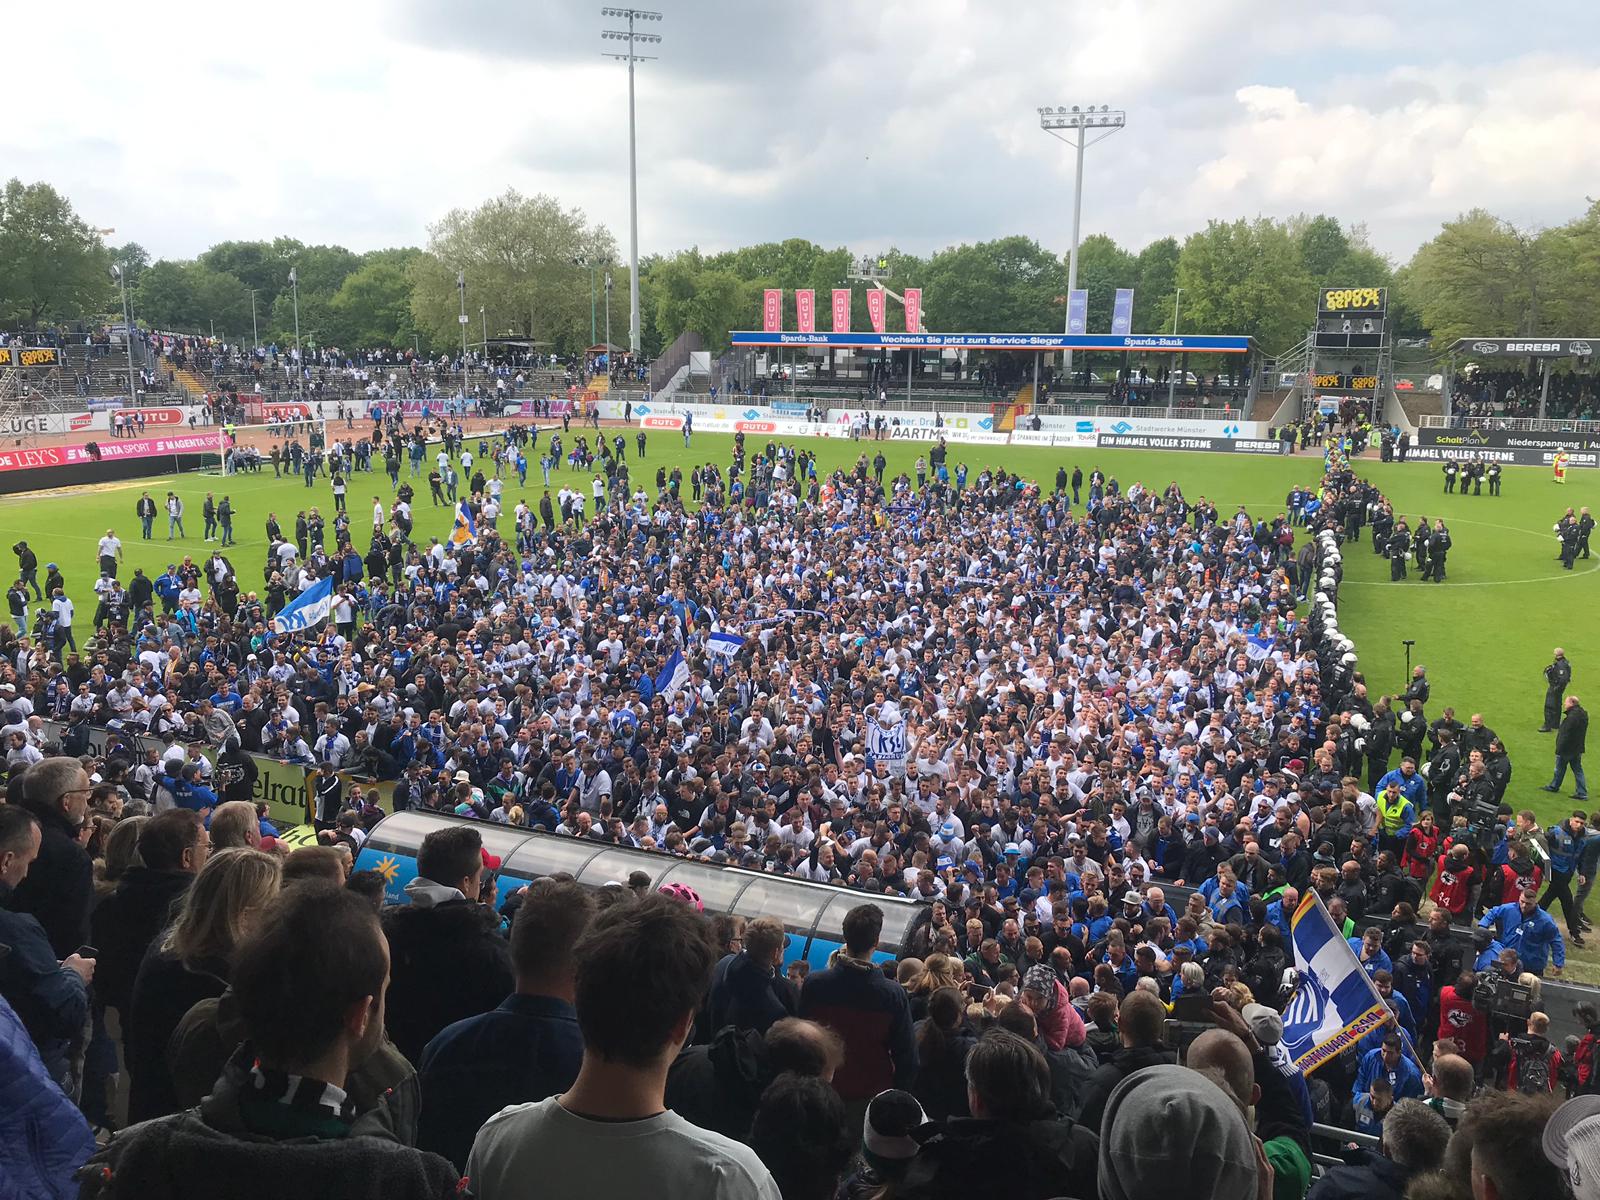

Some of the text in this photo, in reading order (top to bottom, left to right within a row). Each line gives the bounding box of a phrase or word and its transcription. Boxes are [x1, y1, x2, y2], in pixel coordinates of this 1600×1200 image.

[780, 334, 829, 343] Sparda-Bank
[880, 335, 925, 344] Wechseln
[926, 336, 941, 344] Sie
[943, 336, 965, 346] jetzt
[989, 336, 1064, 346] Service-Sieger
[1124, 337, 1184, 347] Sparda-Bank
[1505, 343, 1561, 352] BERESA
[1136, 424, 1207, 434] Stadtwerke Münster
[166, 438, 205, 450] MAGENTA
[1100, 434, 1212, 449] EIN HIMMEL VOLLER STERNE
[1234, 440, 1280, 450] BERESA
[1436, 435, 1480, 446] SchaltPlan
[1507, 438, 1580, 449] Niederspannung
[80, 442, 151, 458] MENTA SPORT
[1441, 450, 1475, 460] VOLLER
[1478, 451, 1515, 461] STERNE
[14, 449, 59, 467] LEY'S
[1543, 453, 1596, 462] BESA
